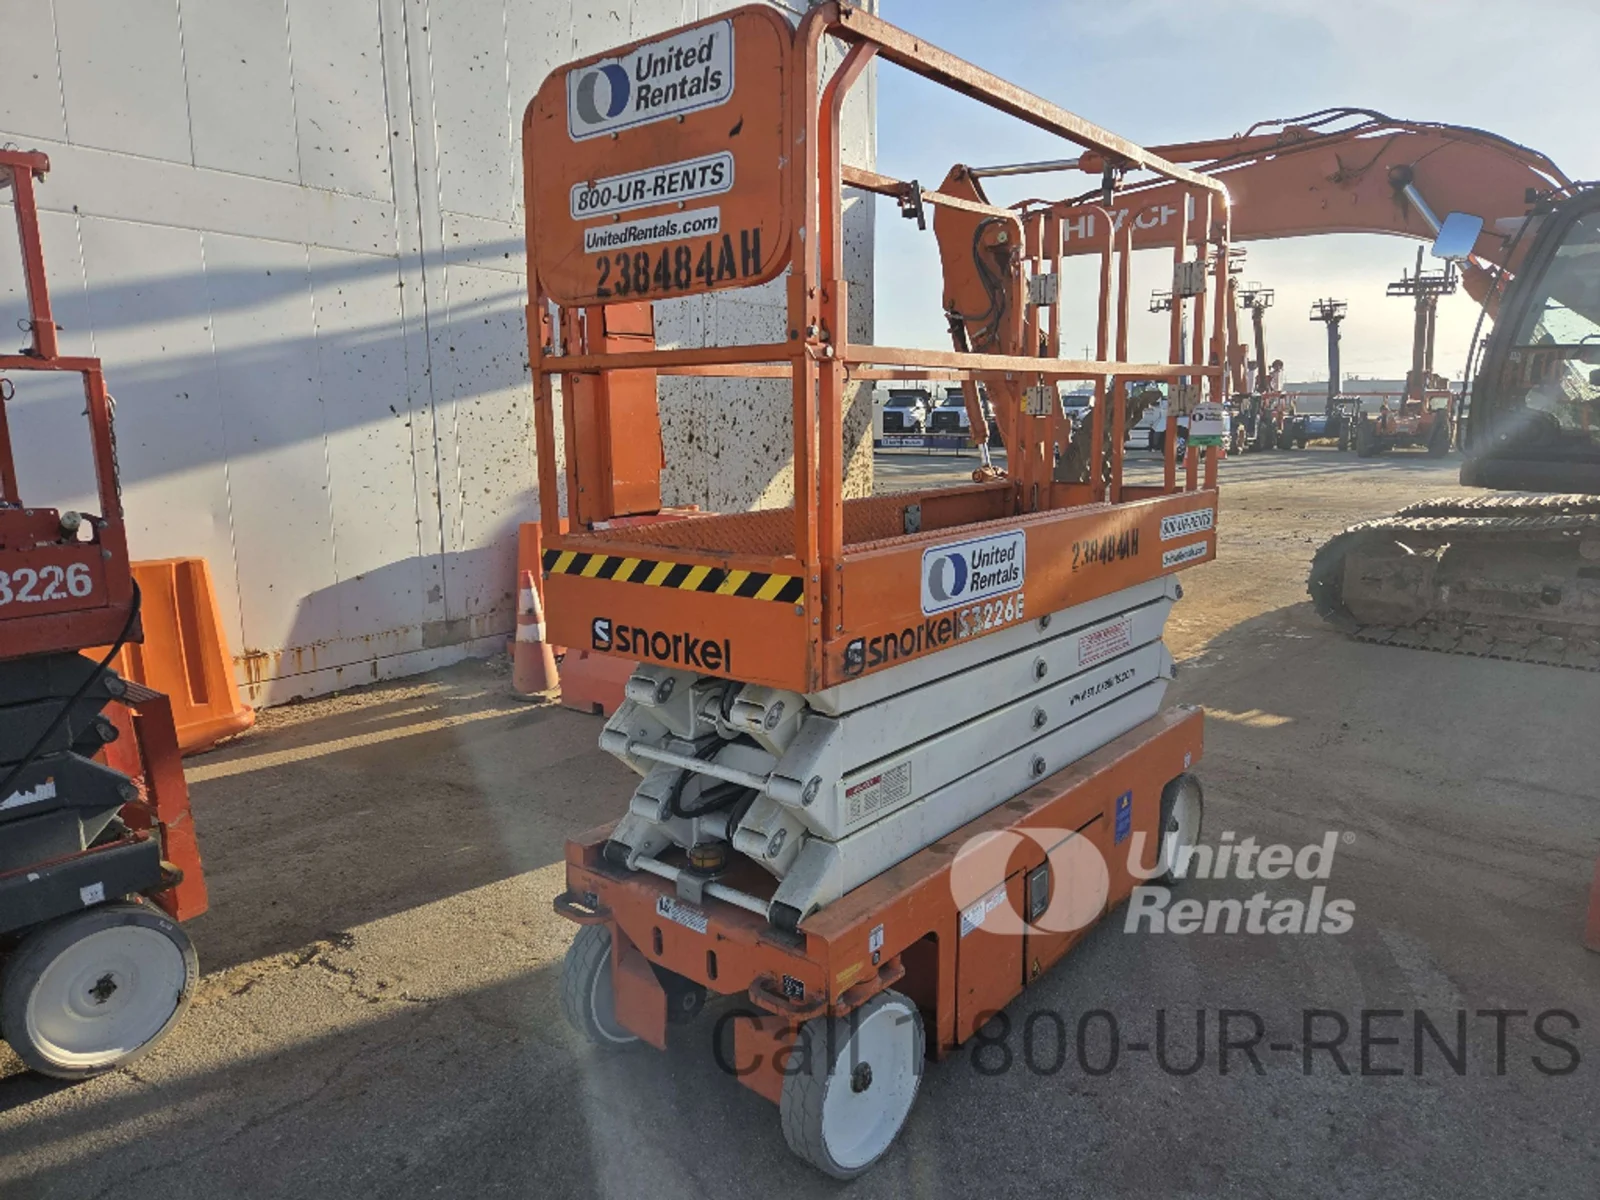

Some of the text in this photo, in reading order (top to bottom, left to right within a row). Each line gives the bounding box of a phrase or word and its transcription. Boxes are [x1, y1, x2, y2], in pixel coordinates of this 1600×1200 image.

[635, 34, 714, 82] United
[635, 66, 722, 111] Rentals
[578, 162, 725, 211] 800-UR-RENTS
[586, 215, 718, 249] UnitedRentals.com
[1063, 196, 1195, 241] HITCHI
[596, 227, 762, 298] 238484AH
[970, 563, 1019, 592] Rentals
[971, 541, 1017, 569] United
[616, 625, 730, 673] snorkel
[868, 611, 958, 668] snorkel
